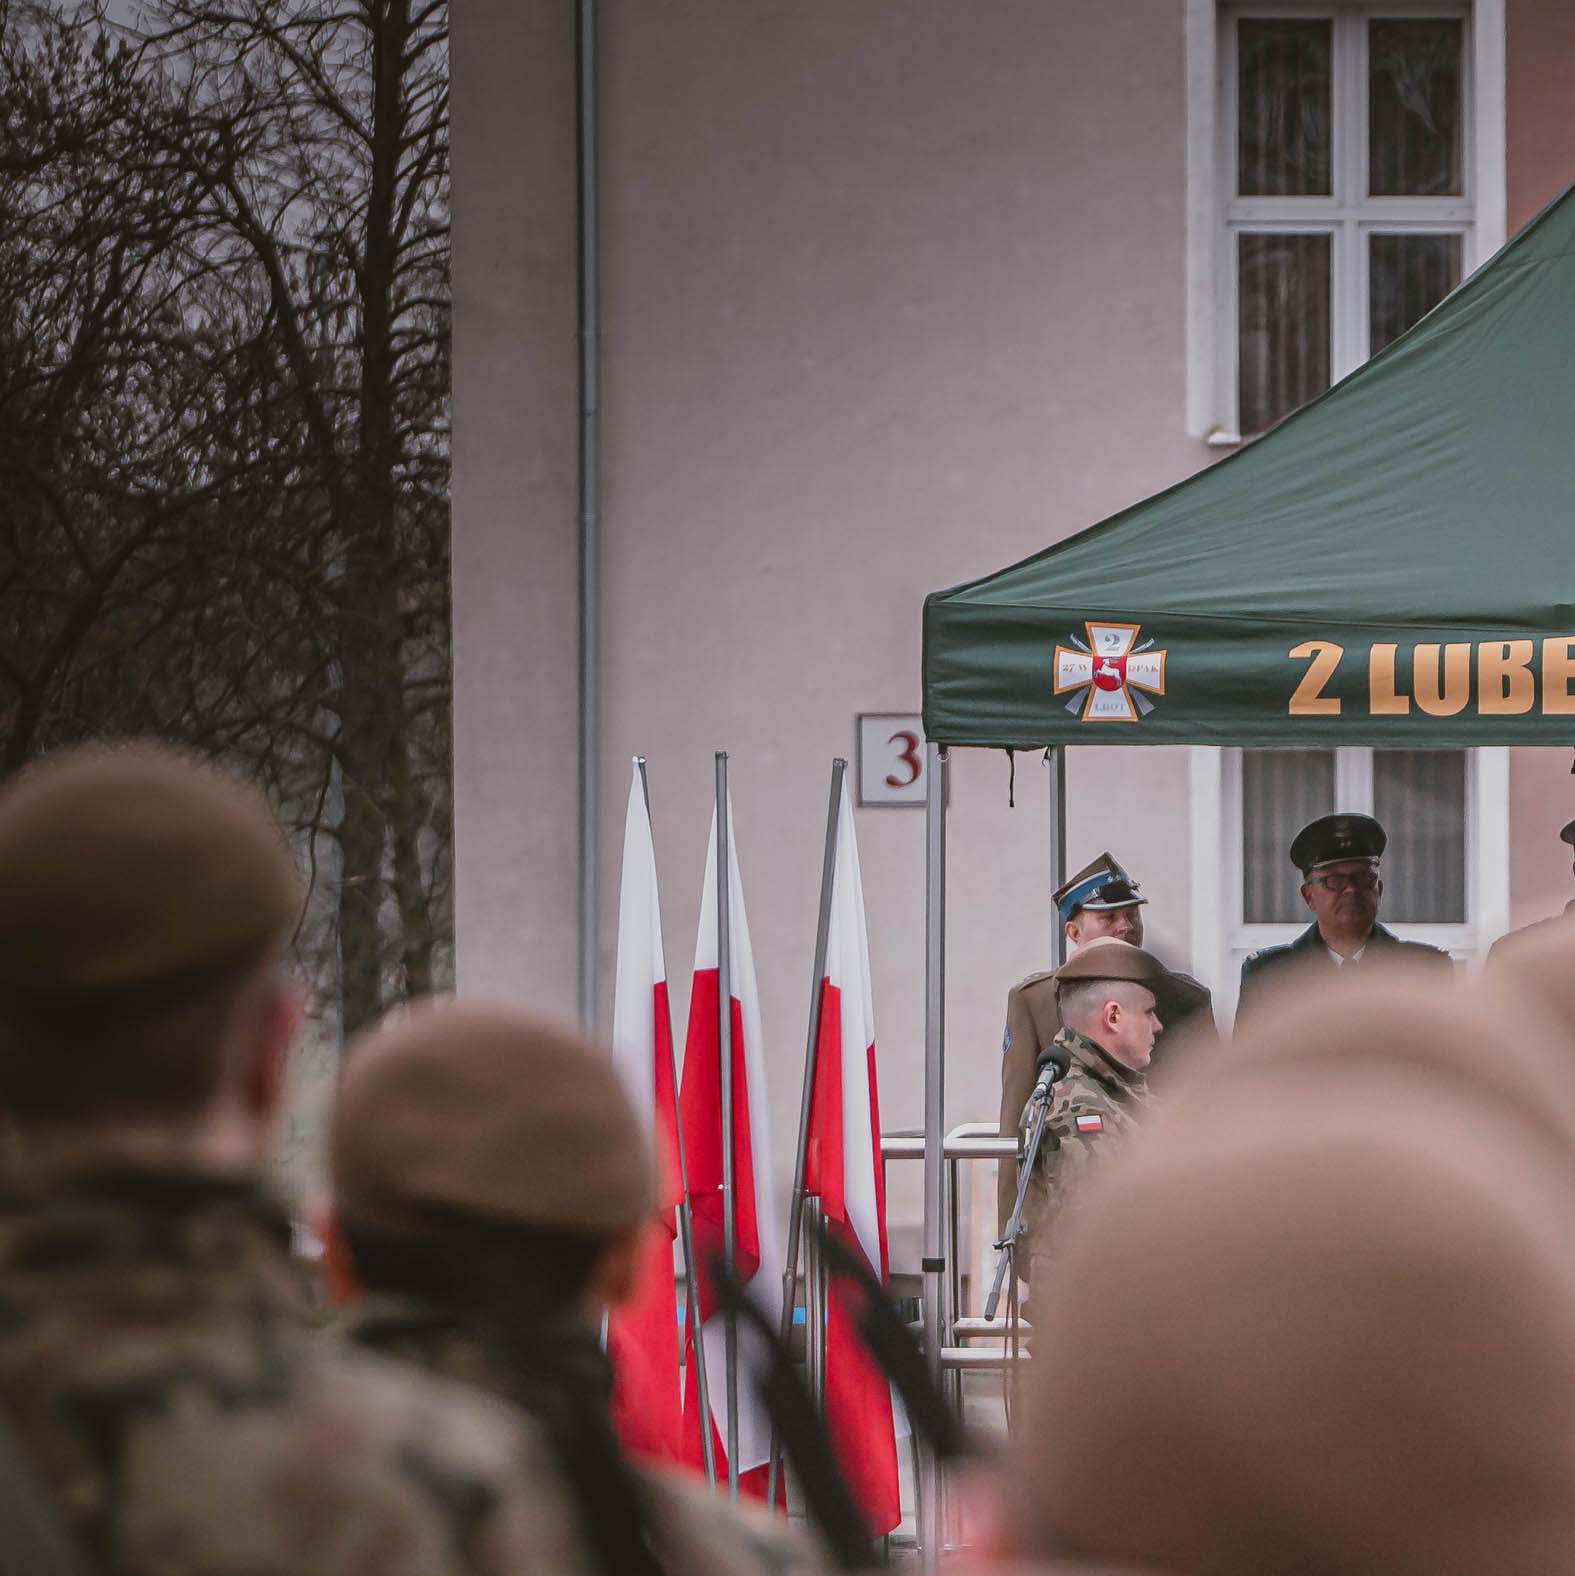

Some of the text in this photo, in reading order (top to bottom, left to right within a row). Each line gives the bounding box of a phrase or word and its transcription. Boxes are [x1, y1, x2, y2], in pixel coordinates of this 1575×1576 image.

[1104, 632, 1121, 652] 2
[1288, 640, 1344, 715] 2
[884, 730, 922, 788] 3
